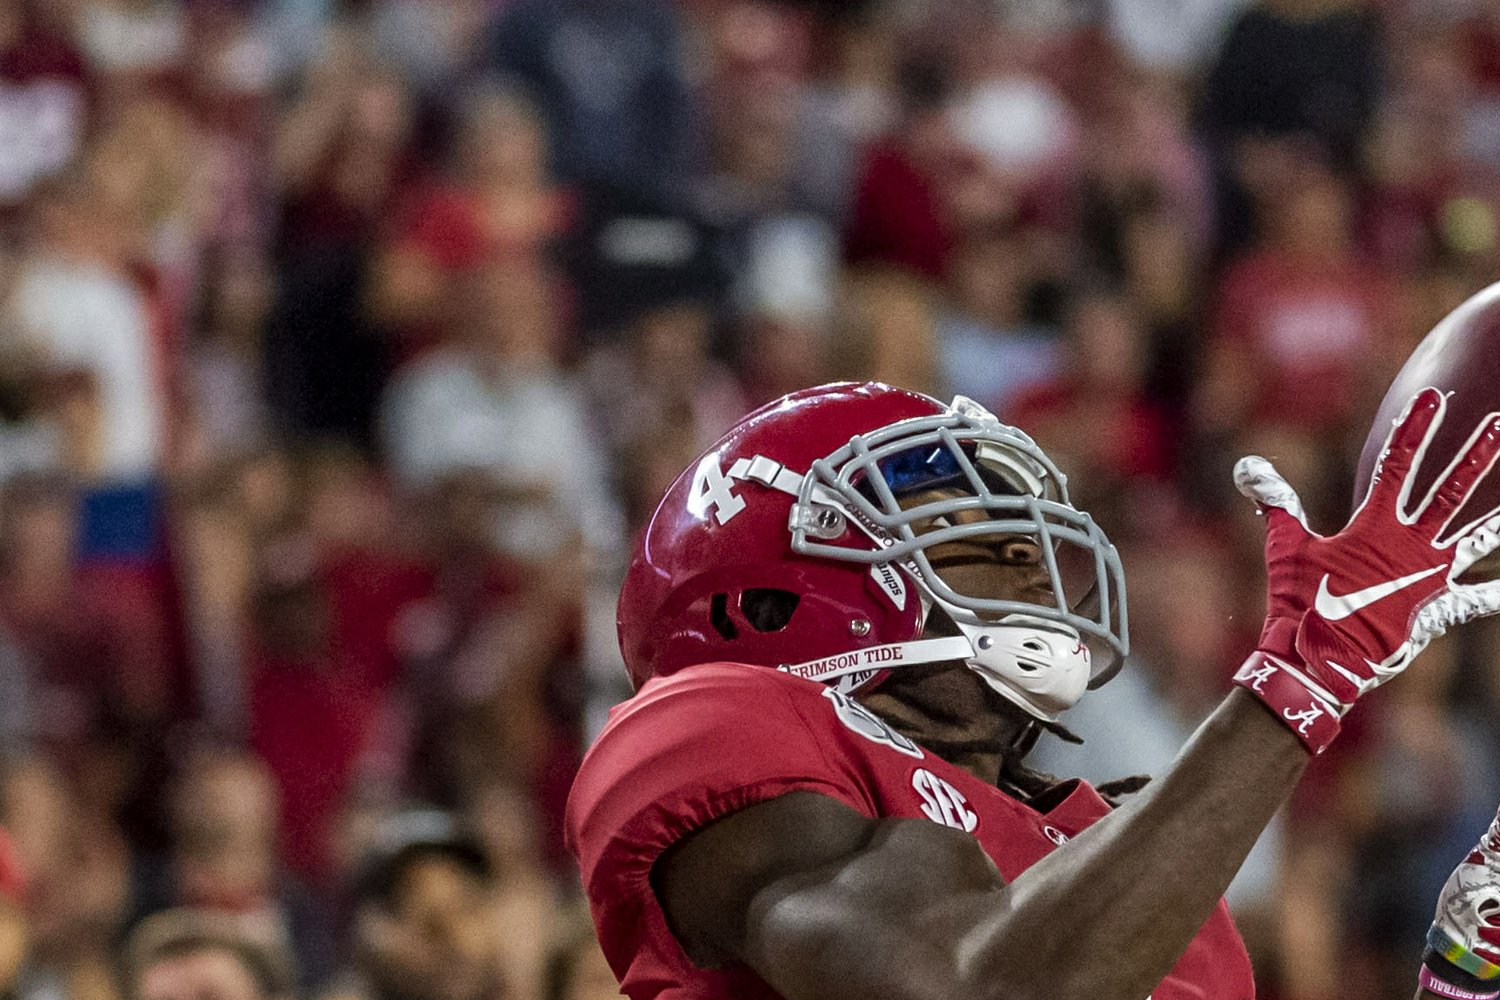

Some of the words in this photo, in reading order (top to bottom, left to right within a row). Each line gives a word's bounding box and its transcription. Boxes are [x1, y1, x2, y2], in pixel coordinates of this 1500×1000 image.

[687, 452, 747, 526] 4
[864, 646, 903, 664] TIDE
[912, 768, 978, 833] SEC
